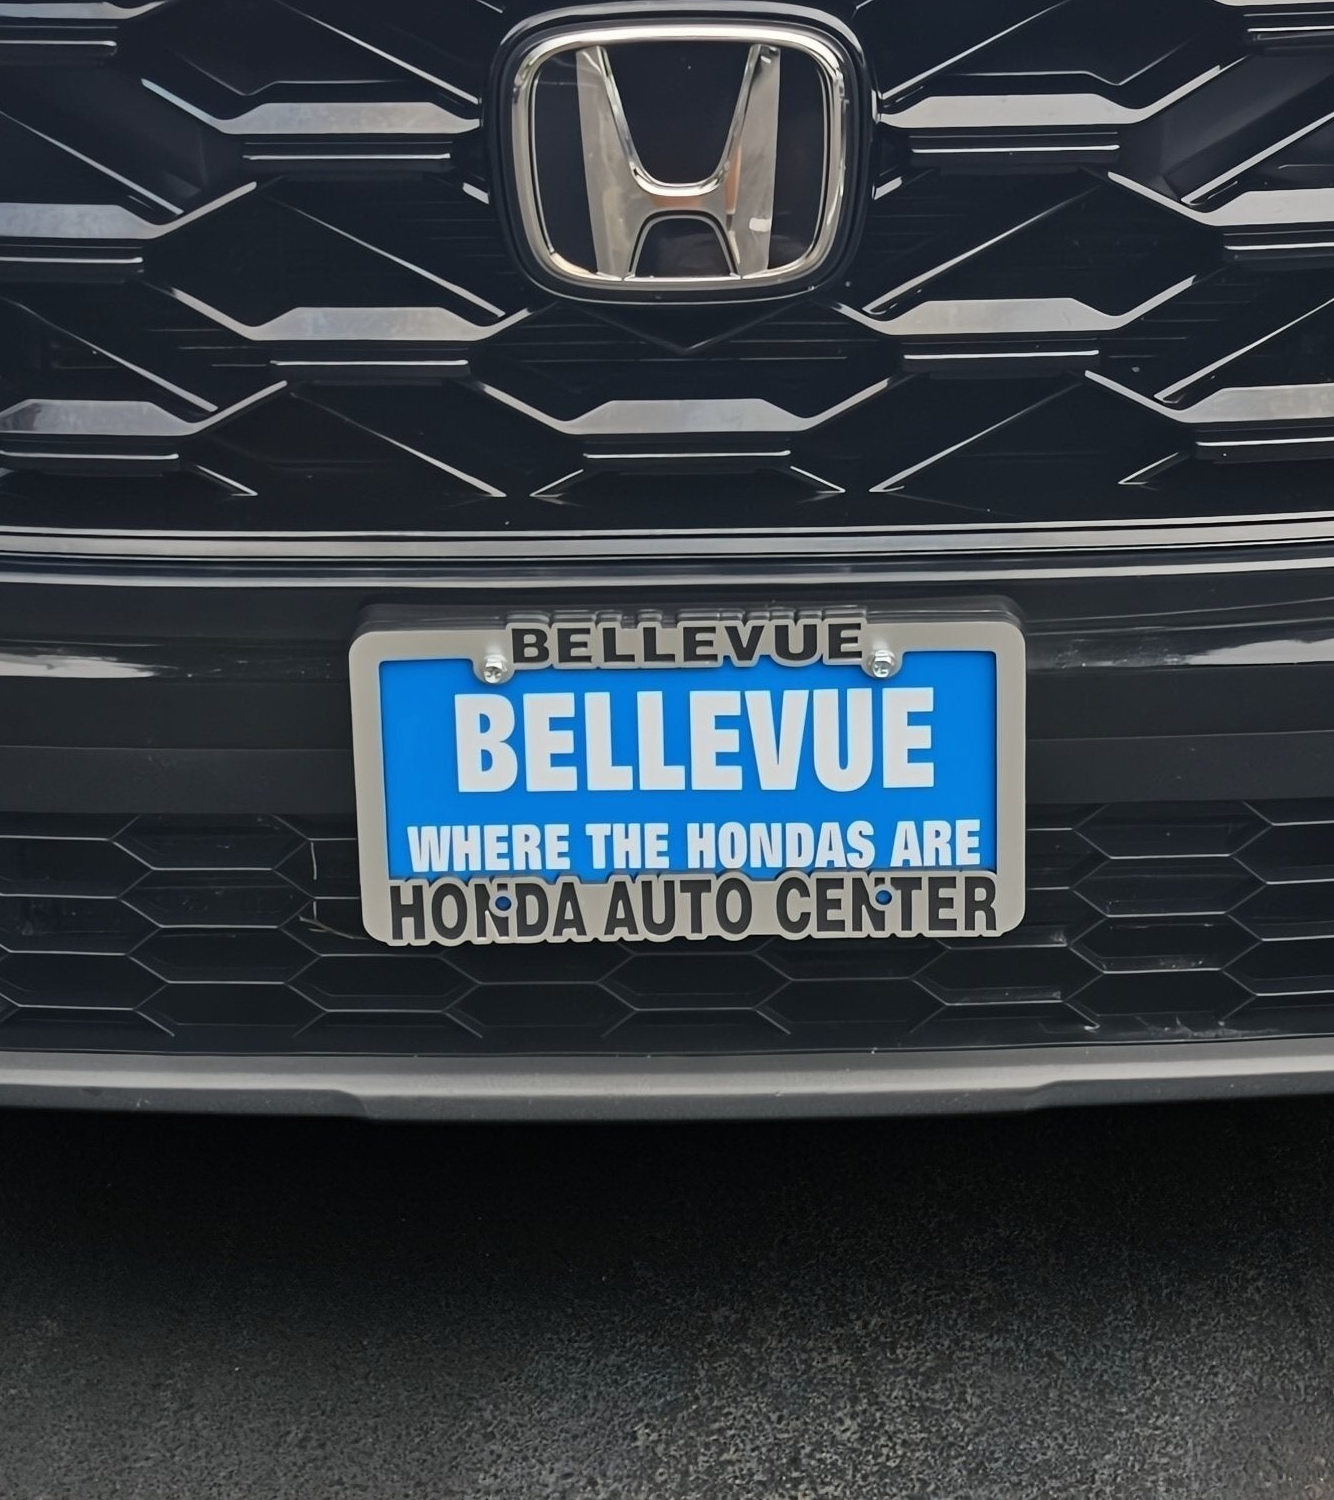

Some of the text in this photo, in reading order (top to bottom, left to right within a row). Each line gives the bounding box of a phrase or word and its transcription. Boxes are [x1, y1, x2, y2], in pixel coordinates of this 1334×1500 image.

[512, 623, 863, 663] BELLEVUE
[454, 687, 934, 792] BELLEVUE
[407, 819, 981, 872] WHERE THE HONDAS ARE
[390, 875, 997, 940] HONDA AUTO CENTER
